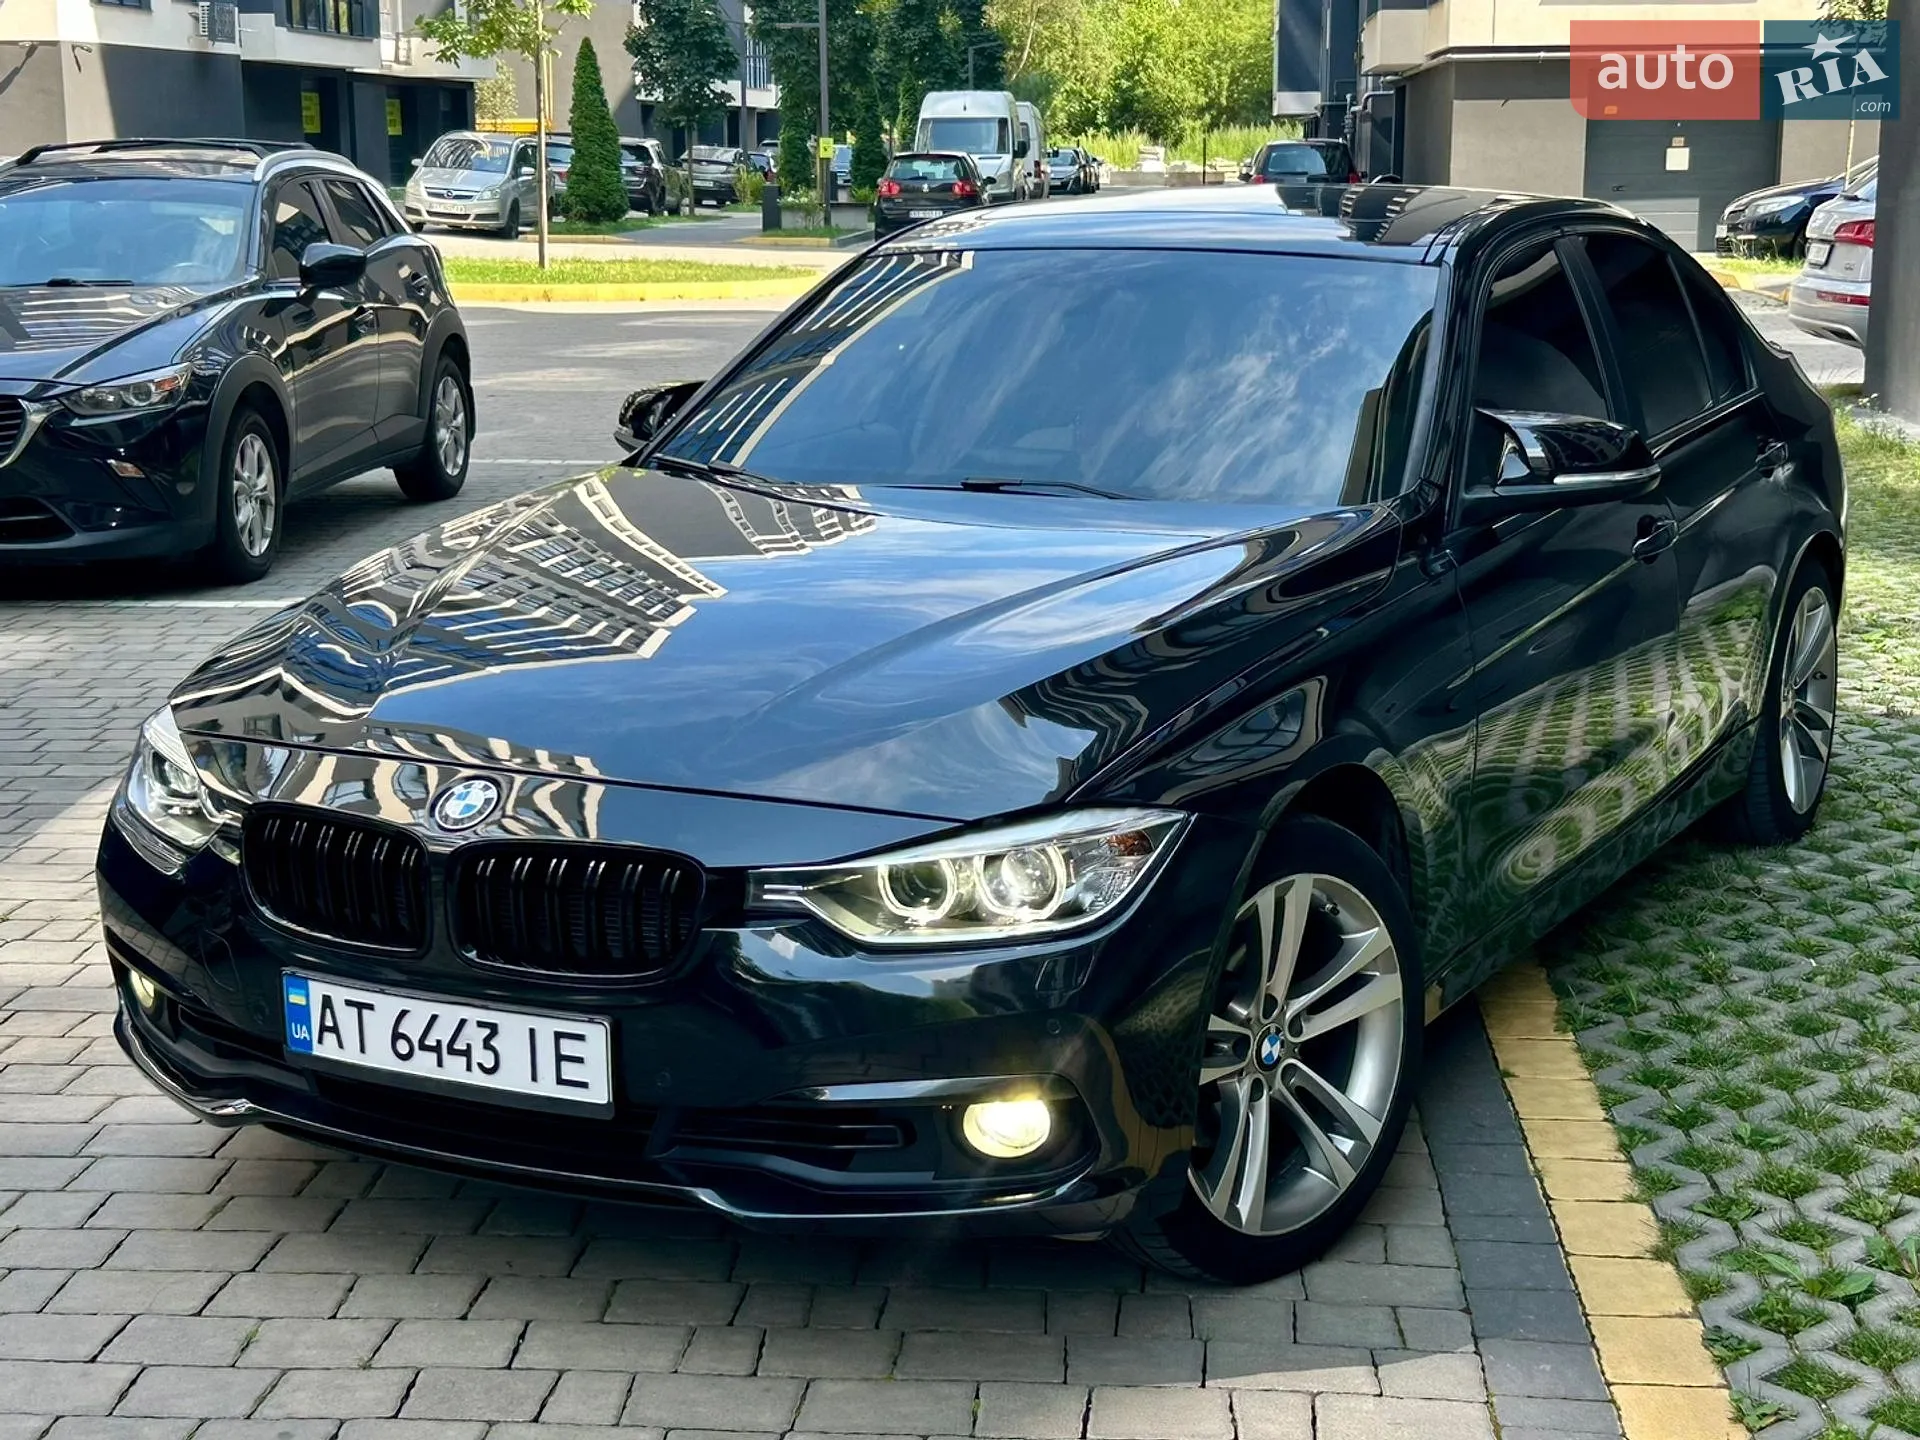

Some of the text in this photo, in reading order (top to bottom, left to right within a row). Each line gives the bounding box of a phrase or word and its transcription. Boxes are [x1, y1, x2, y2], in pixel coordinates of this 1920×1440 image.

[291, 1022, 310, 1041] UA
[317, 994, 590, 1089] AT 6443 IE
